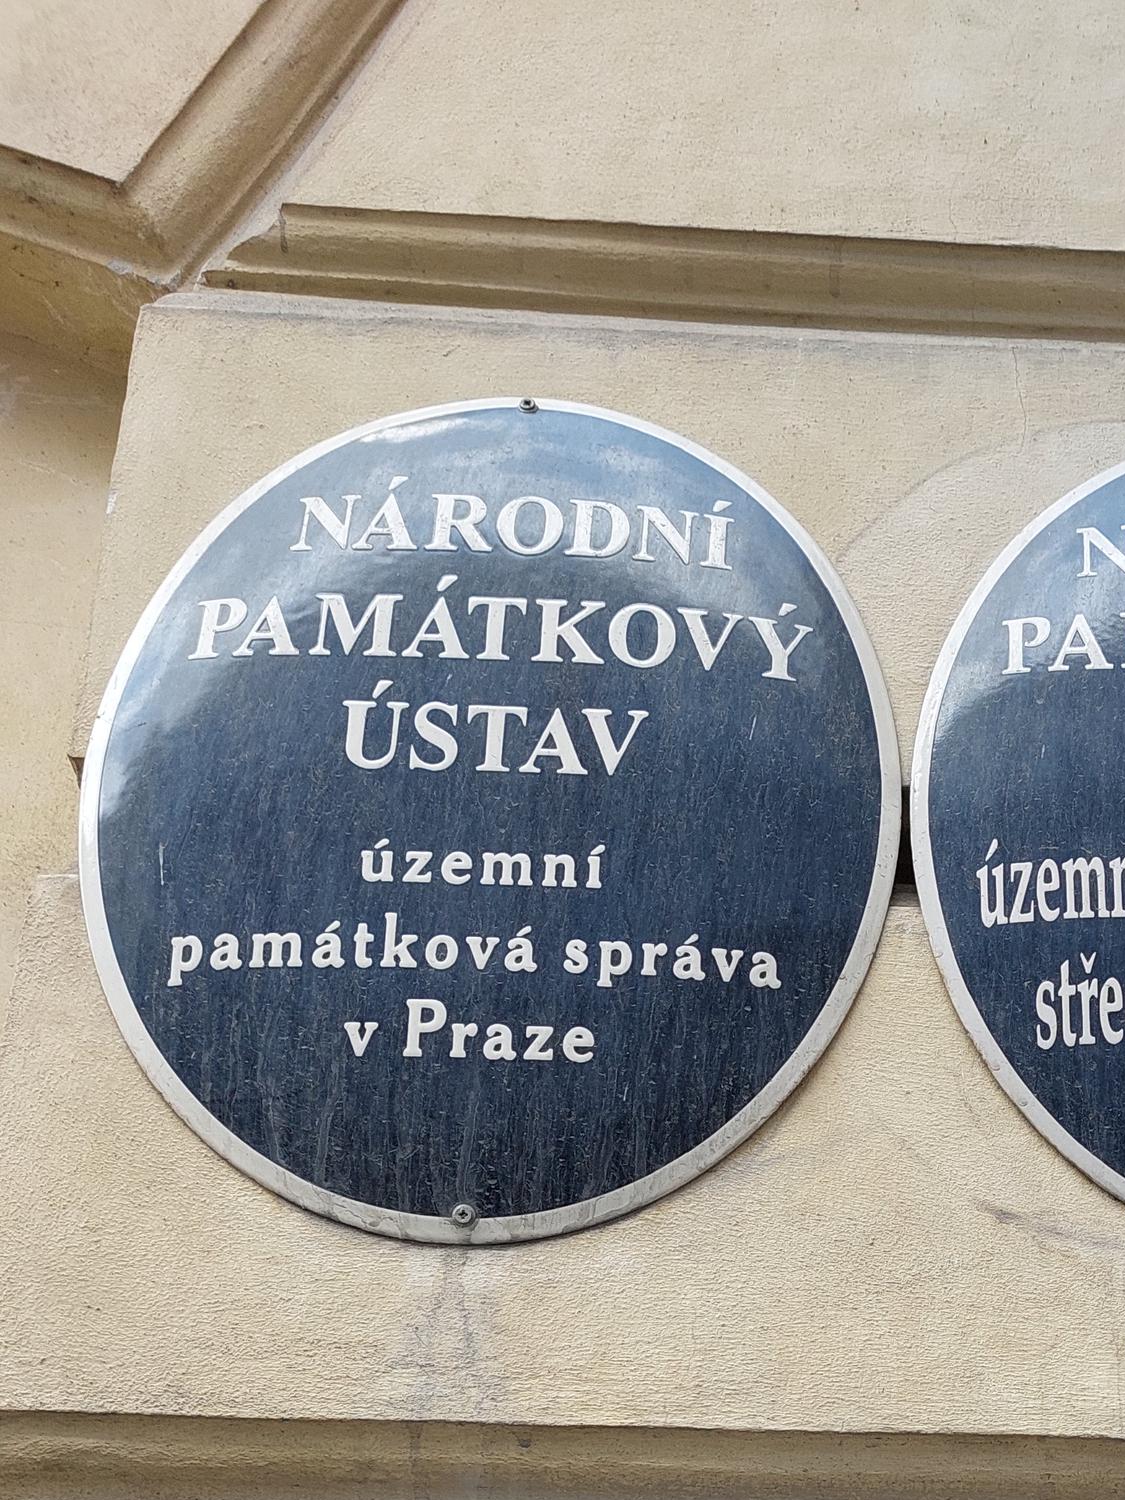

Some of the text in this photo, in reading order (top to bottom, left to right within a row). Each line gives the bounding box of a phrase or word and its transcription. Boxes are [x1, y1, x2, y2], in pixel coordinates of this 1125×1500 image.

[290, 476, 735, 570] NÁRODNÍ
[188, 575, 815, 682] PAMÁTKOVÝ
[342, 680, 650, 776] ÚSTAV
[359, 840, 605, 889] územní
[168, 912, 783, 989] památková správa
[343, 998, 597, 1062] v Praze
